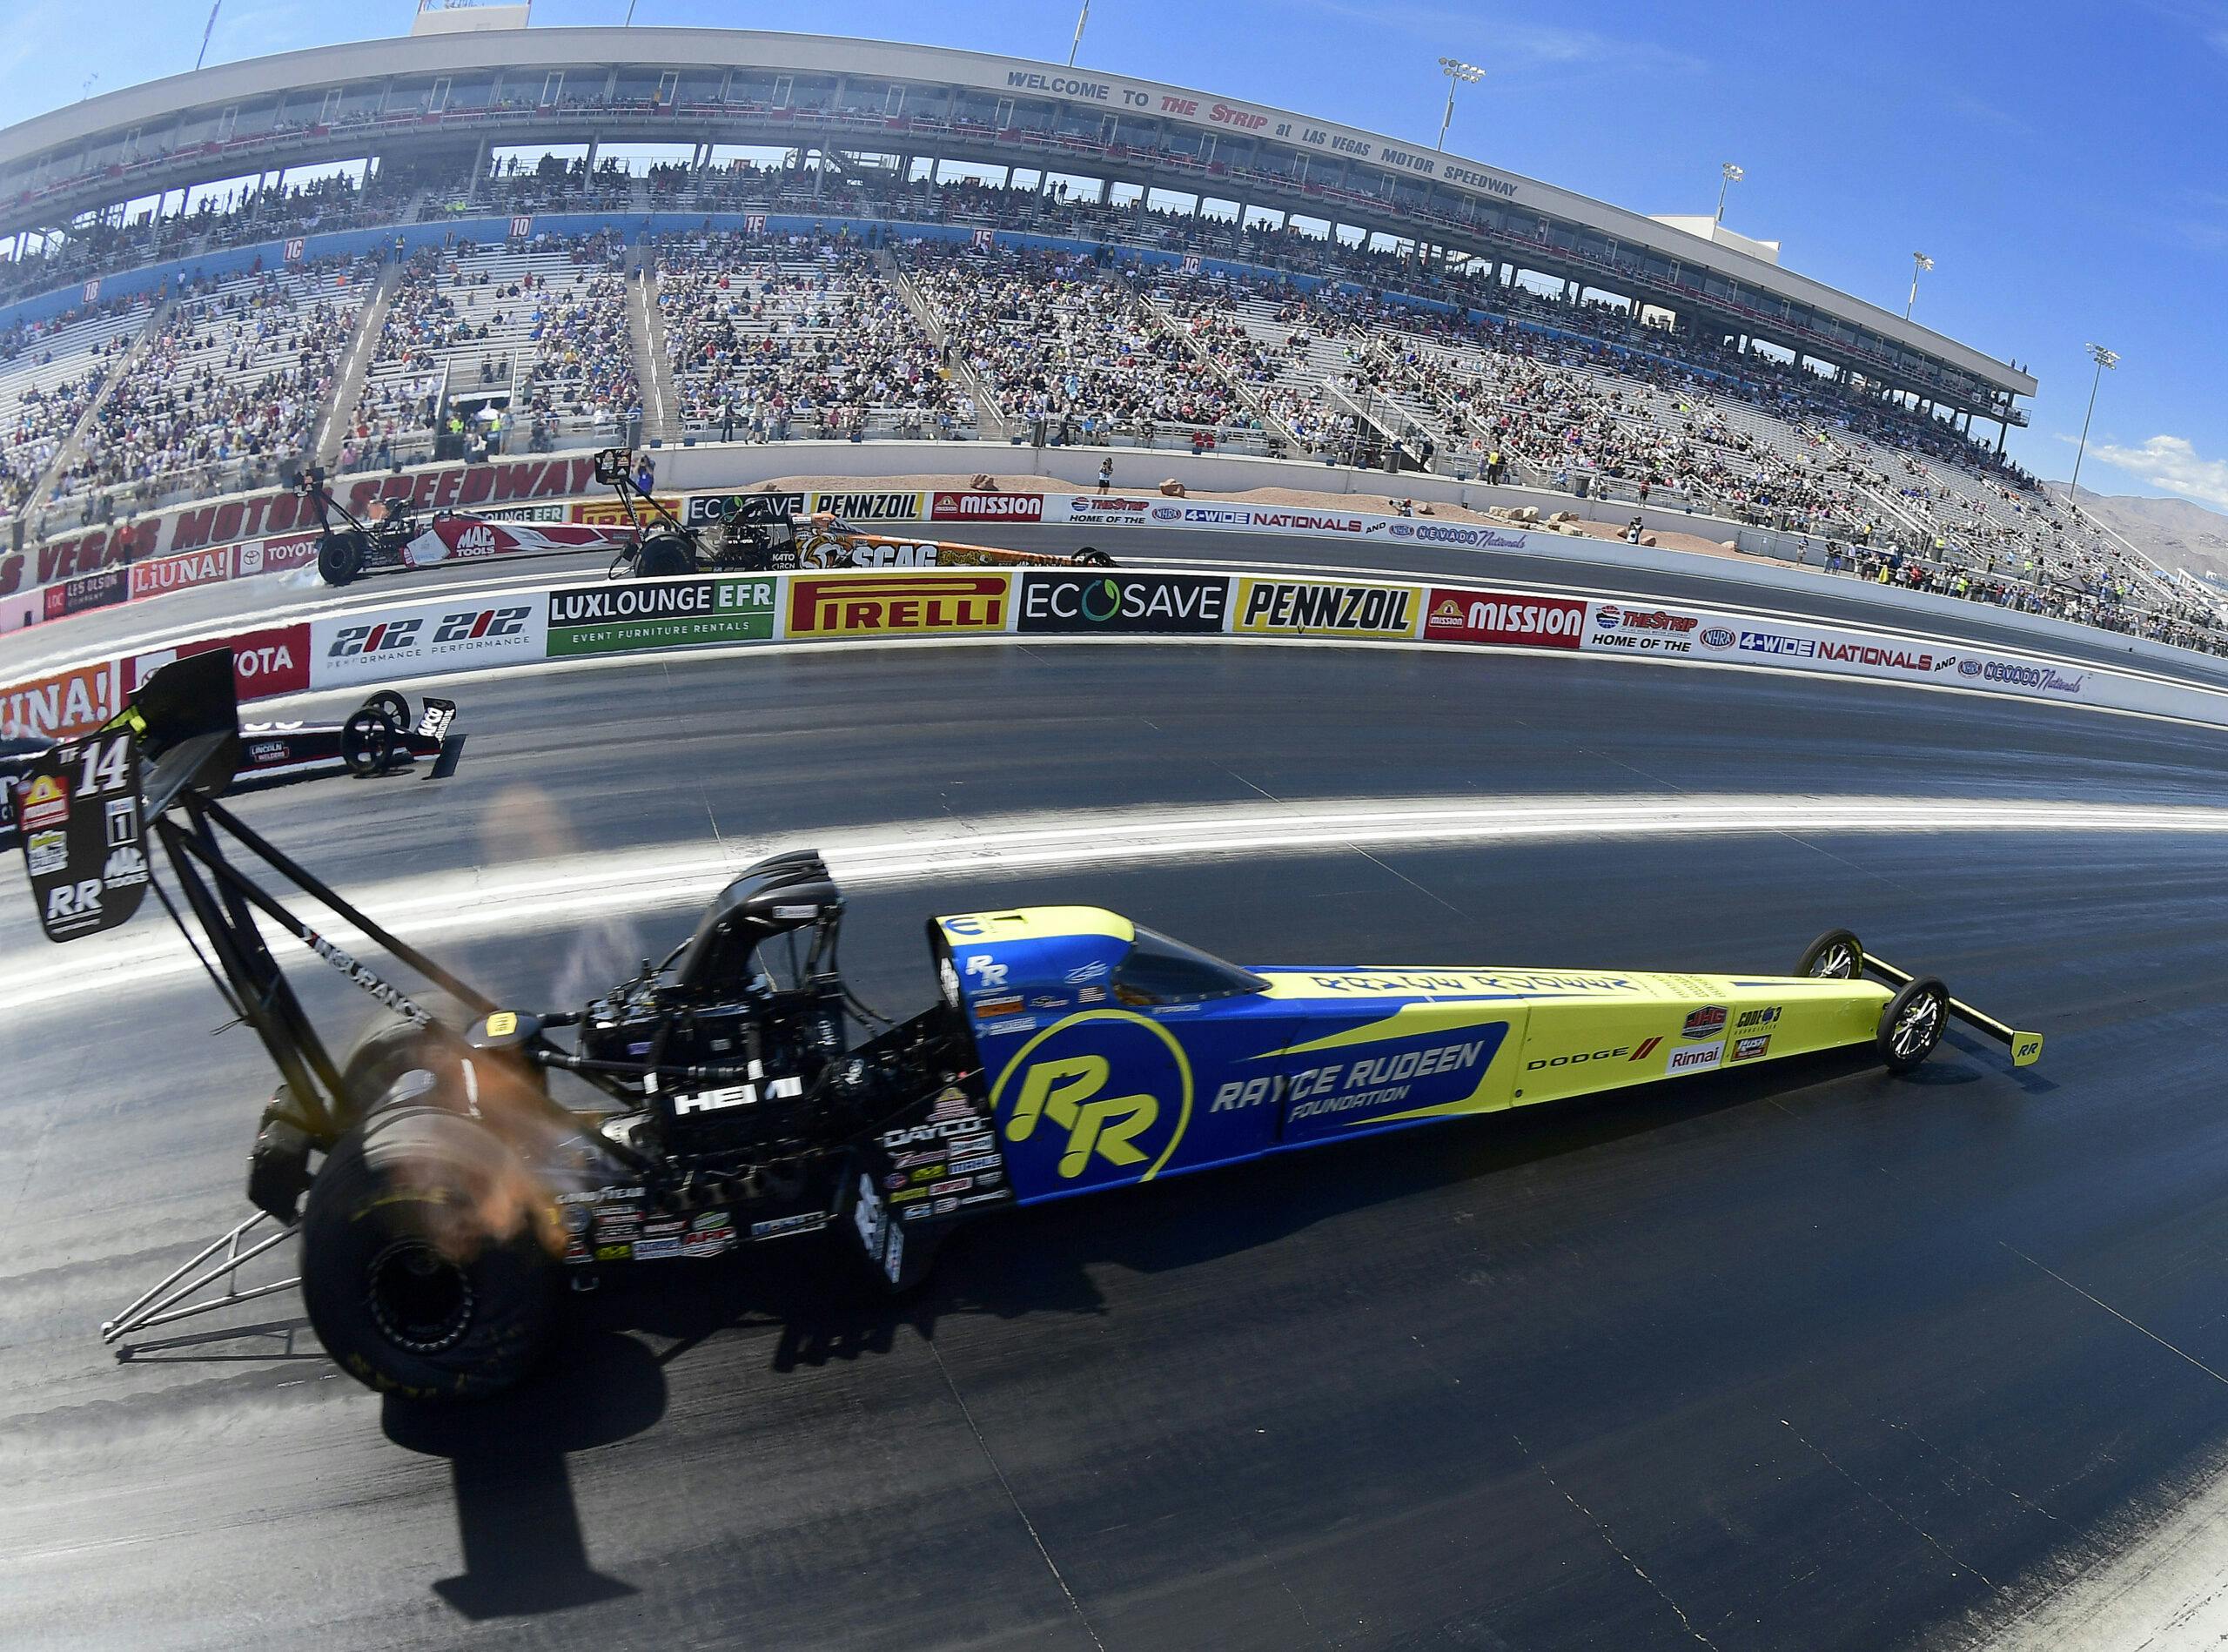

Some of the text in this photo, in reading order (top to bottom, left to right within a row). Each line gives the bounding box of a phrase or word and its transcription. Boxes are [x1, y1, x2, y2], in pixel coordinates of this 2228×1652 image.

[1007, 71, 1518, 197] WELCOME TO THE STRIP at LAS VEGAS MOTOR SPEEDWAY
[534, 507, 561, 521] EFR
[816, 494, 919, 519] PENNZOIL
[1069, 514, 1146, 525] HOME OF THE
[457, 526, 496, 548] MAC
[1186, 510, 1249, 524] 4-WIDE
[1254, 512, 1362, 533] NATIONALS
[1366, 522, 1386, 534] AND
[1417, 526, 1478, 545] NEVADA
[456, 546, 496, 557] TOOLS
[772, 553, 795, 561] KATO
[551, 585, 712, 621] LUXLOUNGE
[791, 577, 1006, 632] PIRELLI
[1244, 583, 1410, 630] PENNZOIL
[328, 606, 532, 657] 212 212
[431, 635, 530, 655] PERFORMANCE
[572, 621, 749, 643] EVENT FURNITURE RENTALS
[1592, 634, 1692, 653] HOME OF THE
[1705, 630, 1731, 645] NHRA
[1741, 632, 1813, 657] 4-WIDE
[1818, 641, 1933, 672] NATIONALS
[1934, 656, 1956, 672] AND
[1983, 661, 2041, 688] NEVADA
[2037, 668, 2083, 694] Nationals
[58, 735, 131, 797] TF 14
[47, 878, 104, 919] RR
[965, 955, 1009, 986] RR
[1527, 1046, 1629, 1071] DODGE
[1672, 1046, 1720, 1068] Rinnai
[2017, 1042, 2039, 1058] RR
[1209, 1039, 1485, 1113] RAYCE RUDEEN
[1005, 1054, 1159, 1179] RR
[1287, 1085, 1411, 1124] FOUNDATION
